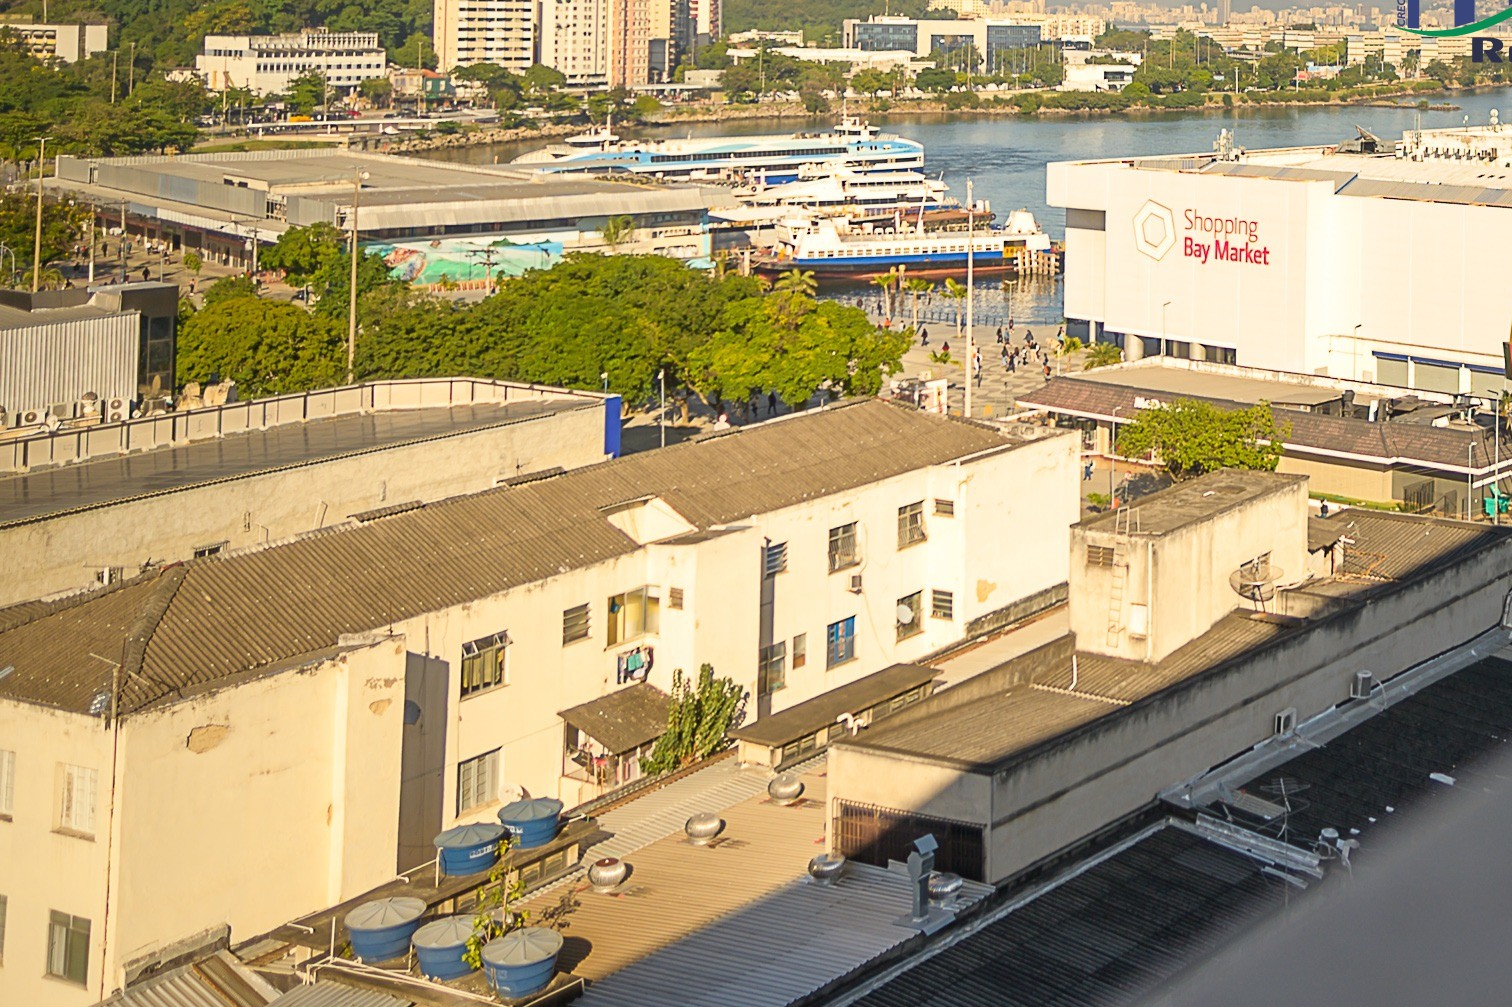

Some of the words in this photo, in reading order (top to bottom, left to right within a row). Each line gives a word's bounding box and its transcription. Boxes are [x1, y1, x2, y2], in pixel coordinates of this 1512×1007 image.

[1184, 208, 1258, 243] Shopping
[1184, 236, 1211, 265] Bay
[1214, 239, 1270, 265] Market
